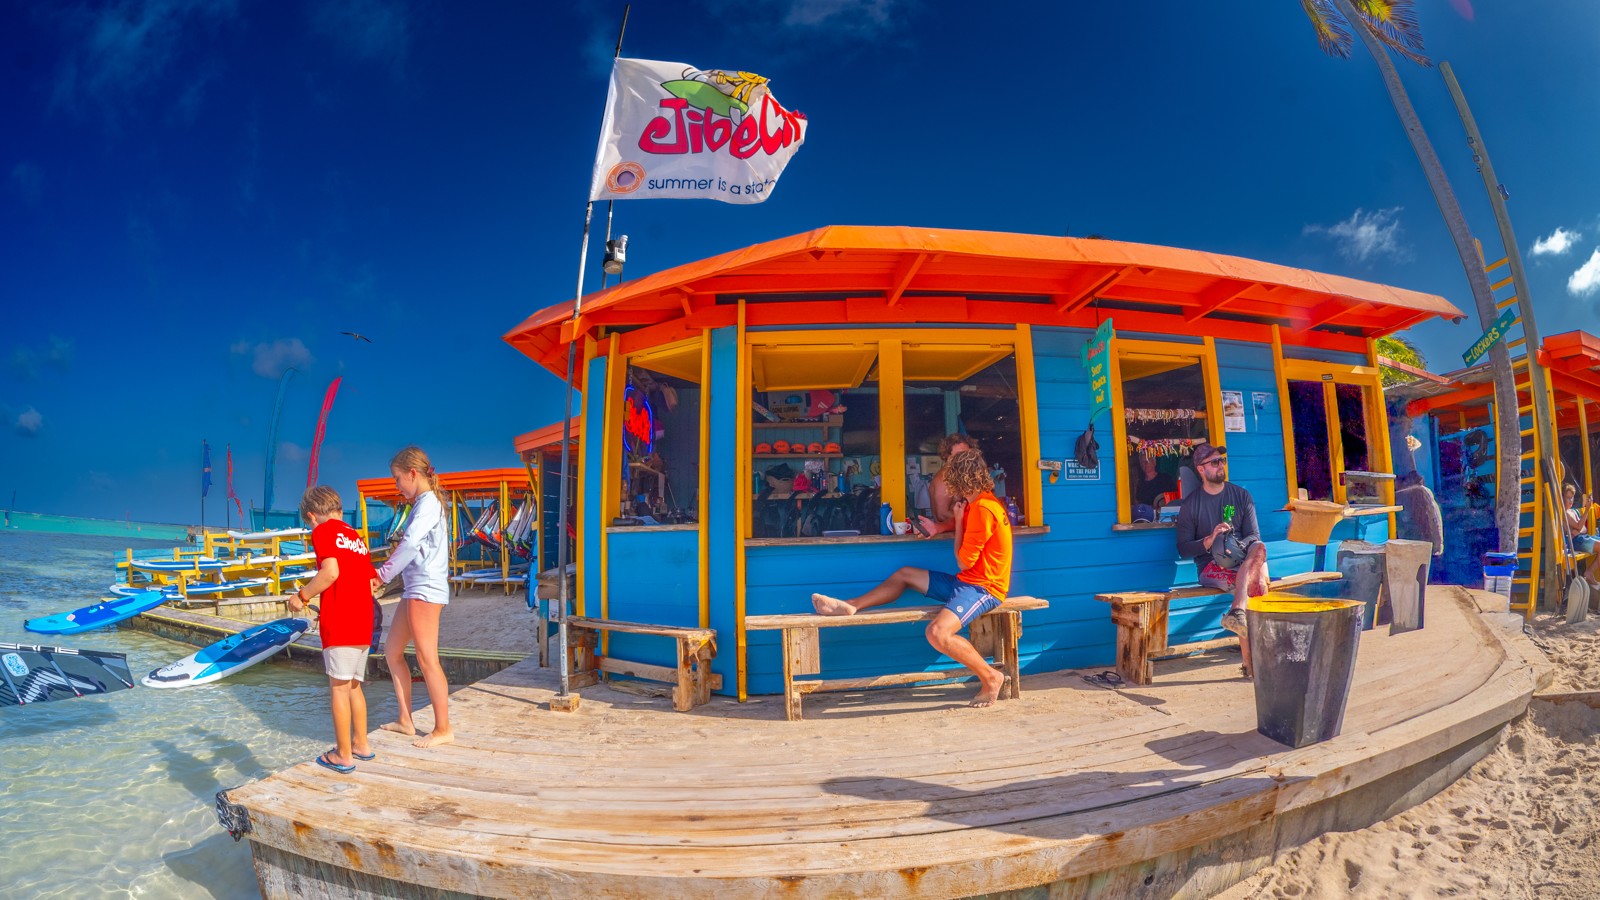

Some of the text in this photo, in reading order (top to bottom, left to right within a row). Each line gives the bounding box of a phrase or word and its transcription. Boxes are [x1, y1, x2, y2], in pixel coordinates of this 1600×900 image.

[648, 177, 713, 190] summer
[718, 177, 727, 191] is
[730, 184, 741, 195] a
